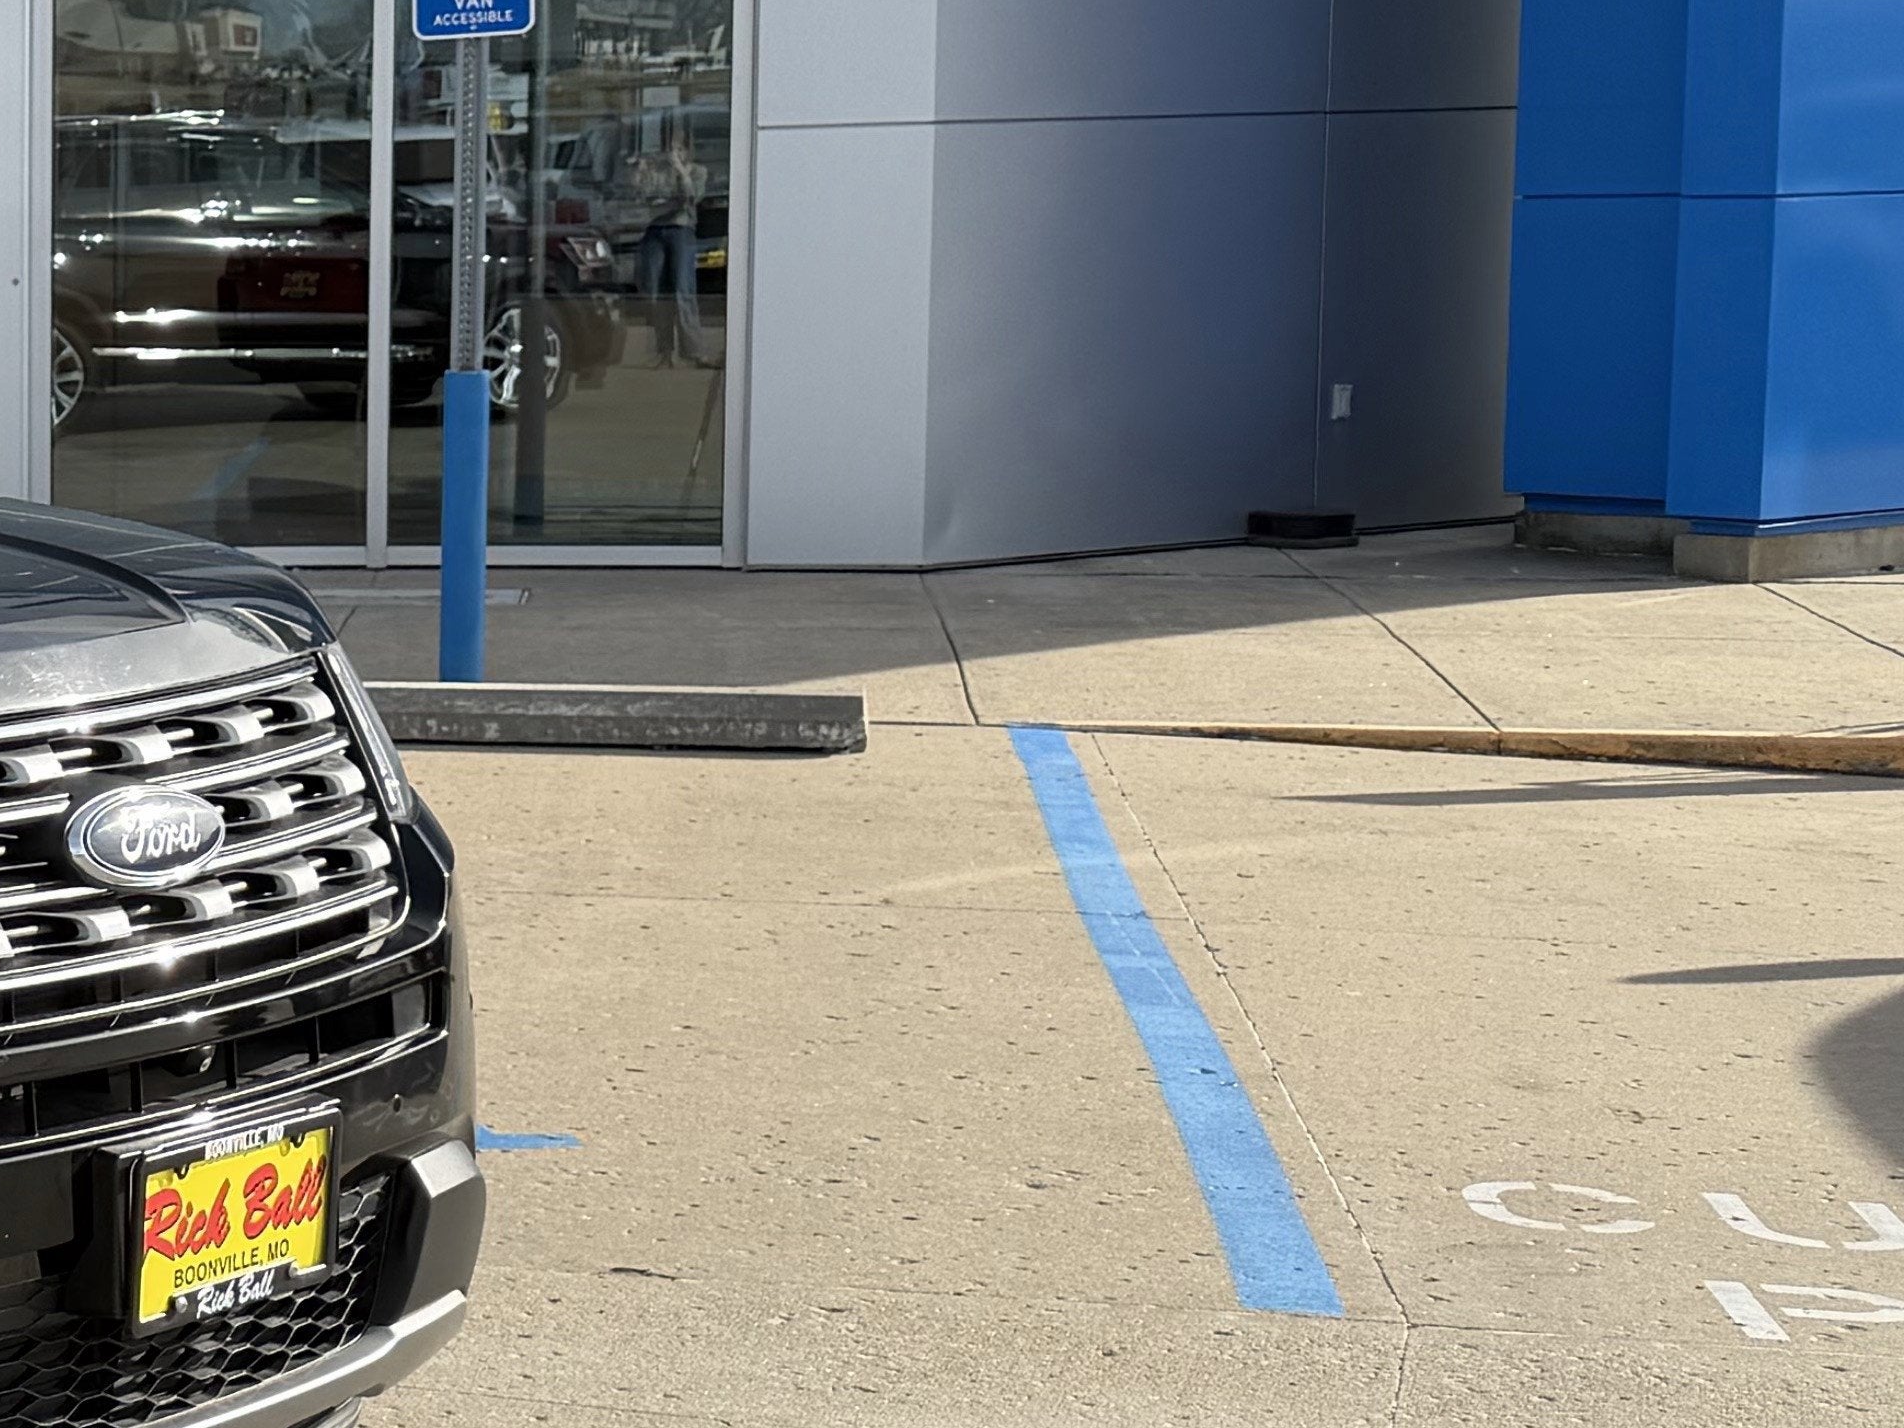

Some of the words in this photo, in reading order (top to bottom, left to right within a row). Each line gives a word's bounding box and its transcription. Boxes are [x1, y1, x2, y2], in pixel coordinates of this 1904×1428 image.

[433, 8, 513, 26] ACCESSIBLE
[114, 802, 202, 864] Ford
[144, 1178, 231, 1261] Rick
[243, 1153, 328, 1240] Ball
[173, 1246, 263, 1289] BOONVILLE,
[267, 1238, 290, 1259] MO
[196, 1285, 236, 1319] Rick
[238, 1270, 275, 1302] Ball
